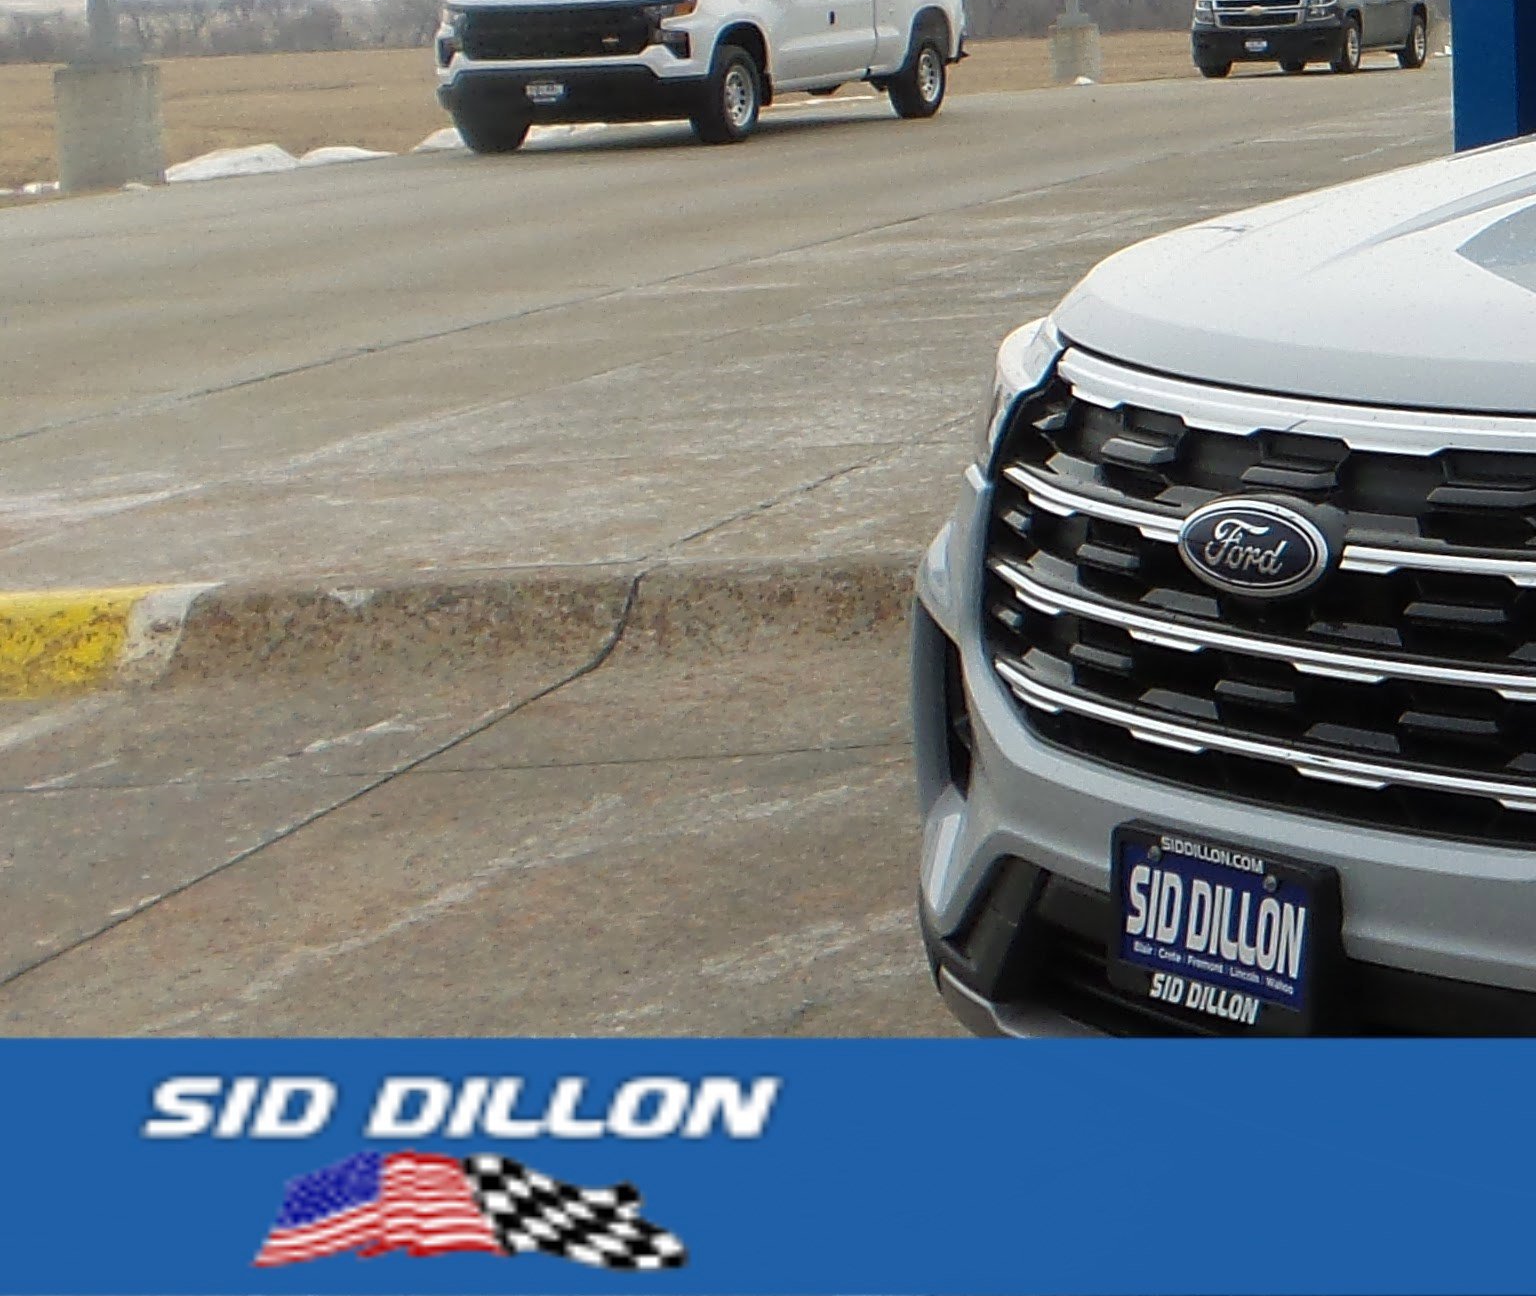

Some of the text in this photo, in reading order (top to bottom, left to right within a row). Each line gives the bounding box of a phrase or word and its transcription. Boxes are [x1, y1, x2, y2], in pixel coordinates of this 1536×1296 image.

[1205, 518, 1288, 576] Ford
[1161, 835, 1264, 875] SIDDILLON.COM
[1125, 864, 1306, 980] SID DILLON
[1150, 972, 1260, 1026] SID DILLON
